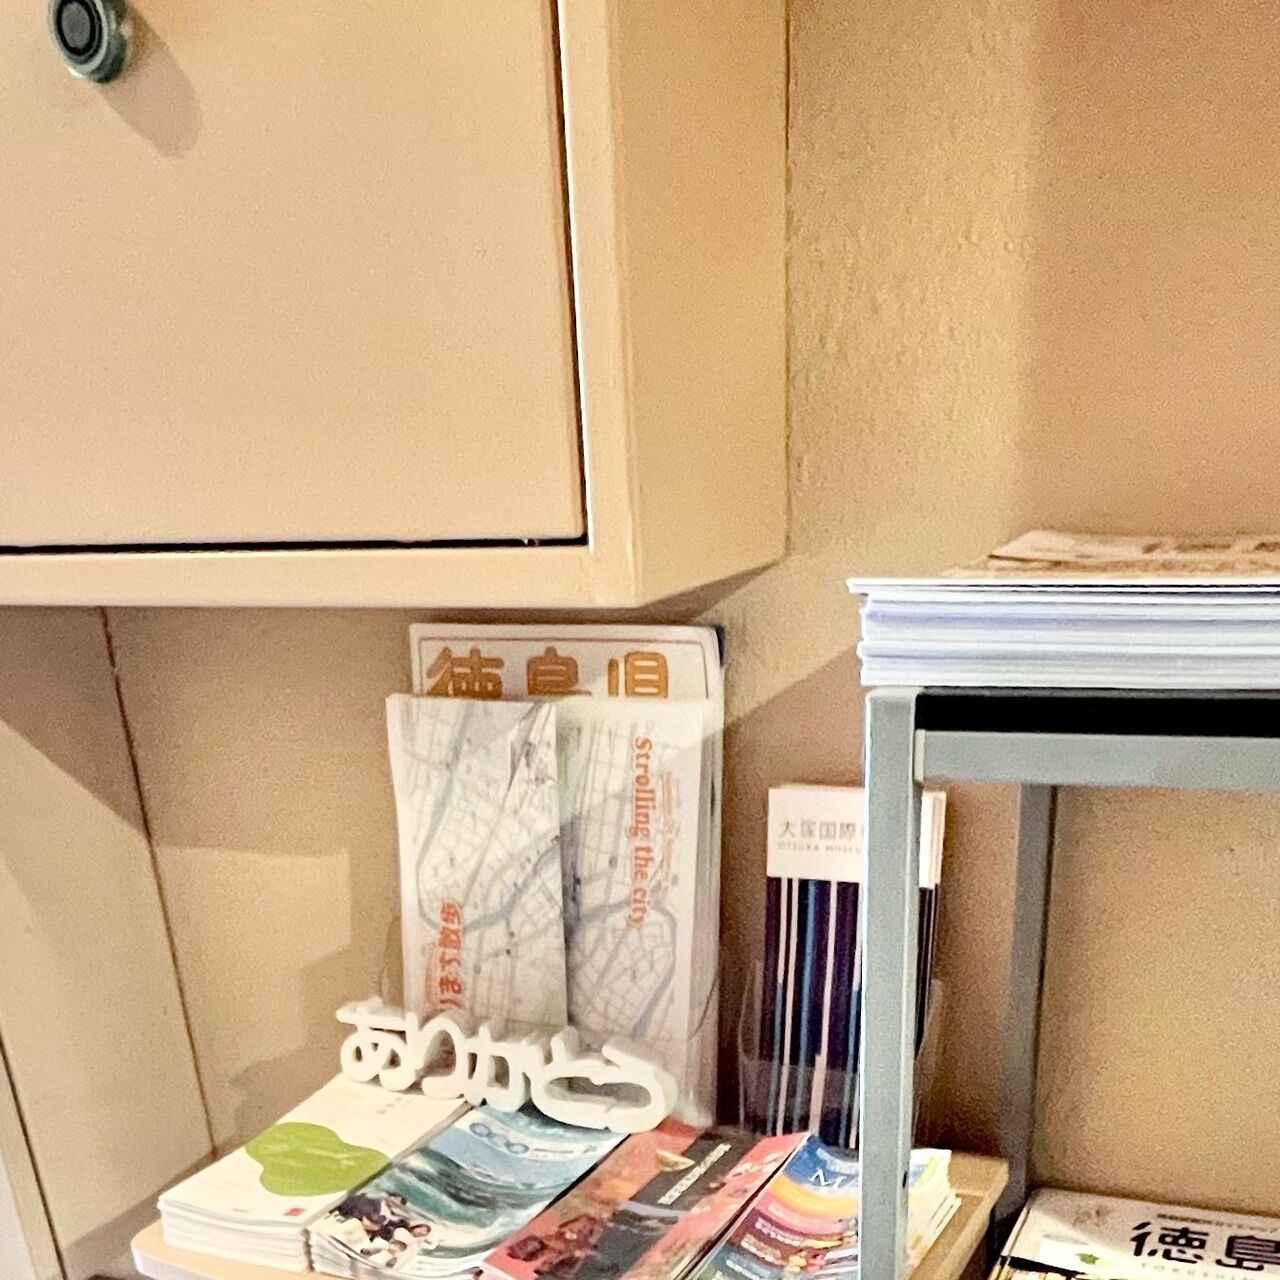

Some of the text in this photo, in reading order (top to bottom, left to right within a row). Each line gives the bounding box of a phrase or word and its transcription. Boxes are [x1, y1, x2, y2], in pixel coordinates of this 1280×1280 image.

[627, 736, 656, 927] Strolling the city
[779, 817, 865, 843] 大塚国際
[336, 996, 678, 1133] ありがとう
